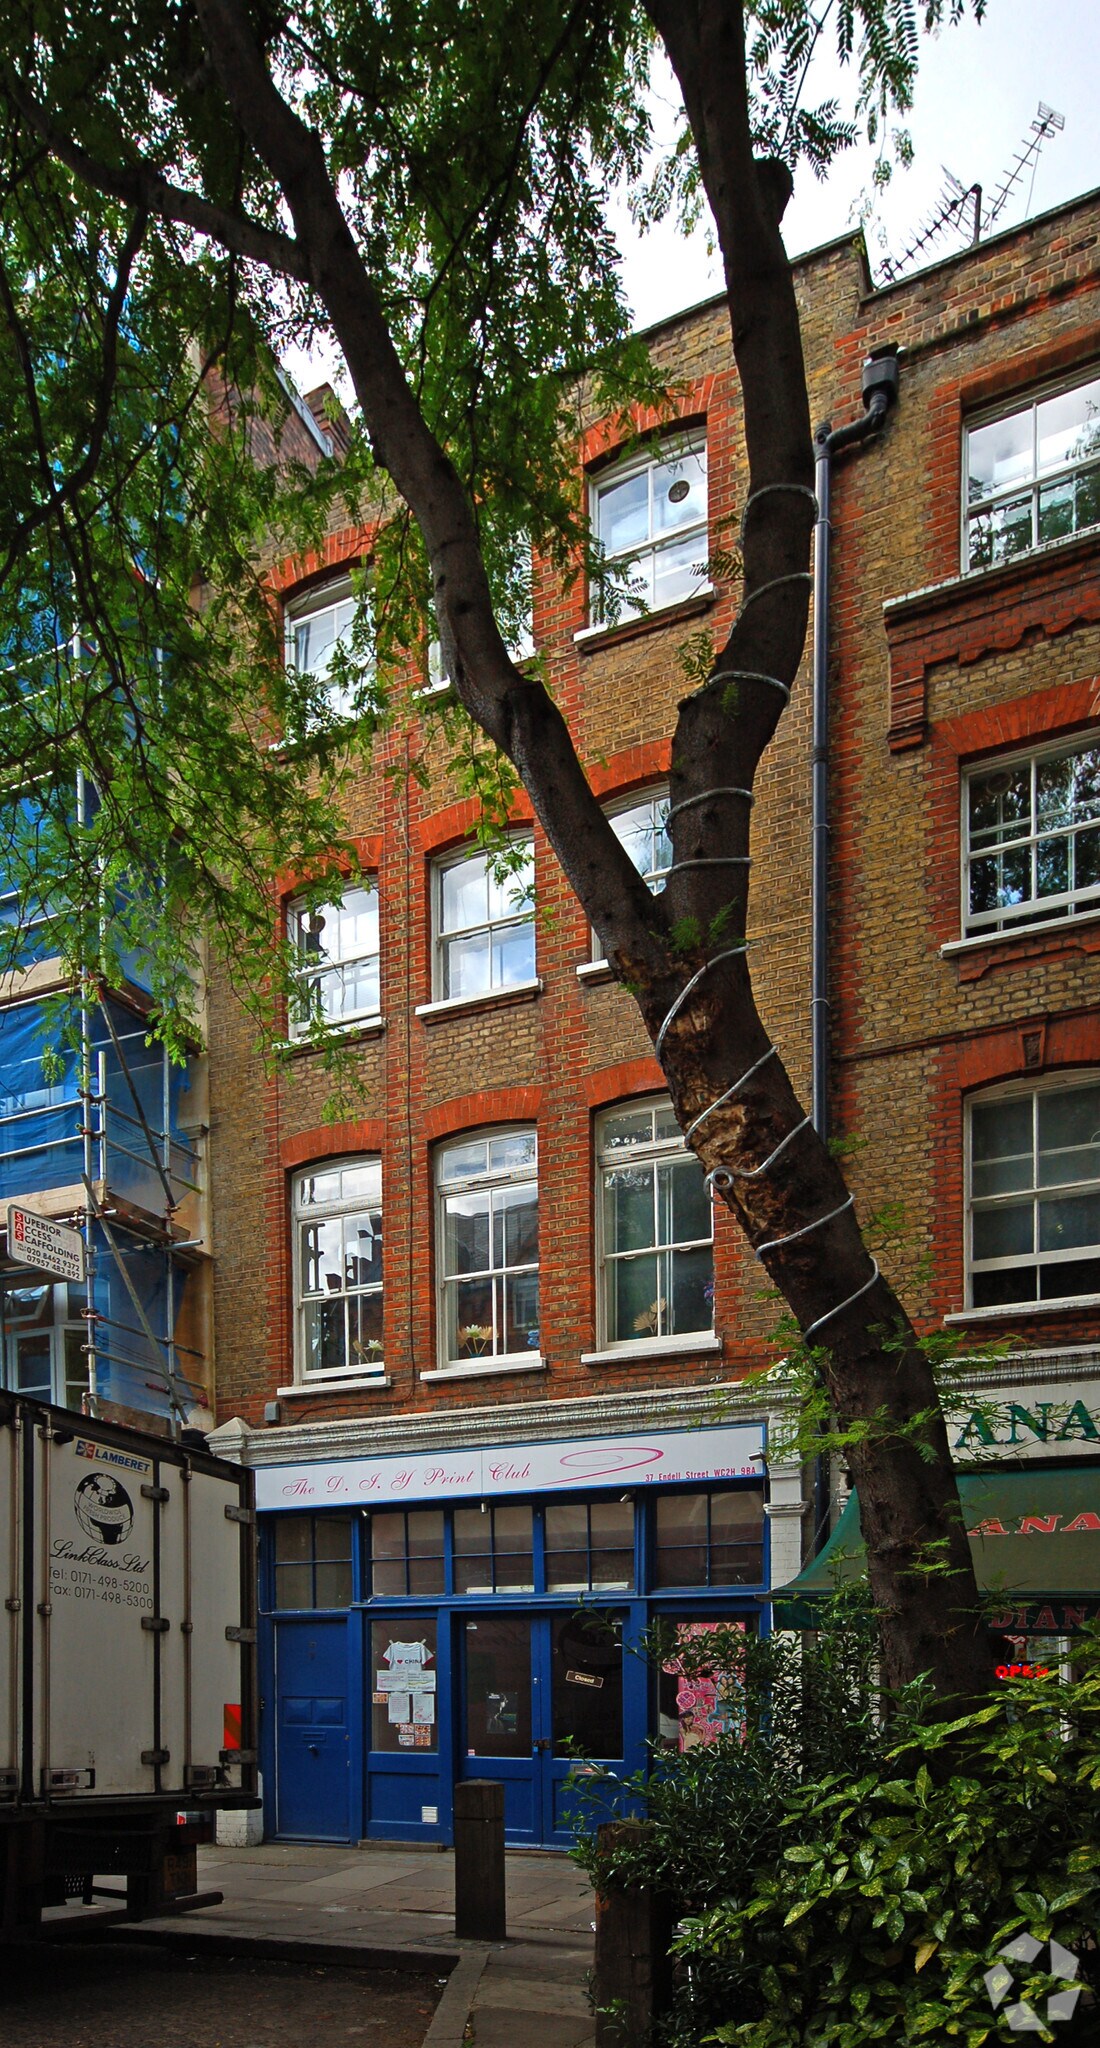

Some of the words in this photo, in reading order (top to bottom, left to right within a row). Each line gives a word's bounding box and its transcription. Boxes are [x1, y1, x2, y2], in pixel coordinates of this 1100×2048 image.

[16, 1211, 61, 1237] SUPERIOR
[16, 1223, 52, 1242] ACCESS
[16, 1232, 80, 1262] SCAFFOLDING
[26, 1246, 41, 1257] 020
[62, 1260, 80, 1272] 9372
[26, 1255, 50, 1268] 07957
[955, 1399, 1100, 1448] ANA
[95, 1448, 150, 1472] LAMBERET
[282, 1478, 316, 1496] The
[424, 1467, 475, 1486] Print
[488, 1461, 532, 1481] Club
[645, 1473, 655, 1482] 37
[658, 1472, 681, 1481] Endell
[685, 1470, 709, 1479] Street
[713, 1468, 736, 1477] WC2H
[967, 1512, 1100, 1536] ANA
[118, 1553, 150, 1574] Ltd
[70, 1570, 150, 1595] 0171-498-5200
[74, 1586, 153, 1609] 0171-498-5300
[988, 1605, 1100, 1629] DIAN
[574, 1674, 595, 1684] Closed
